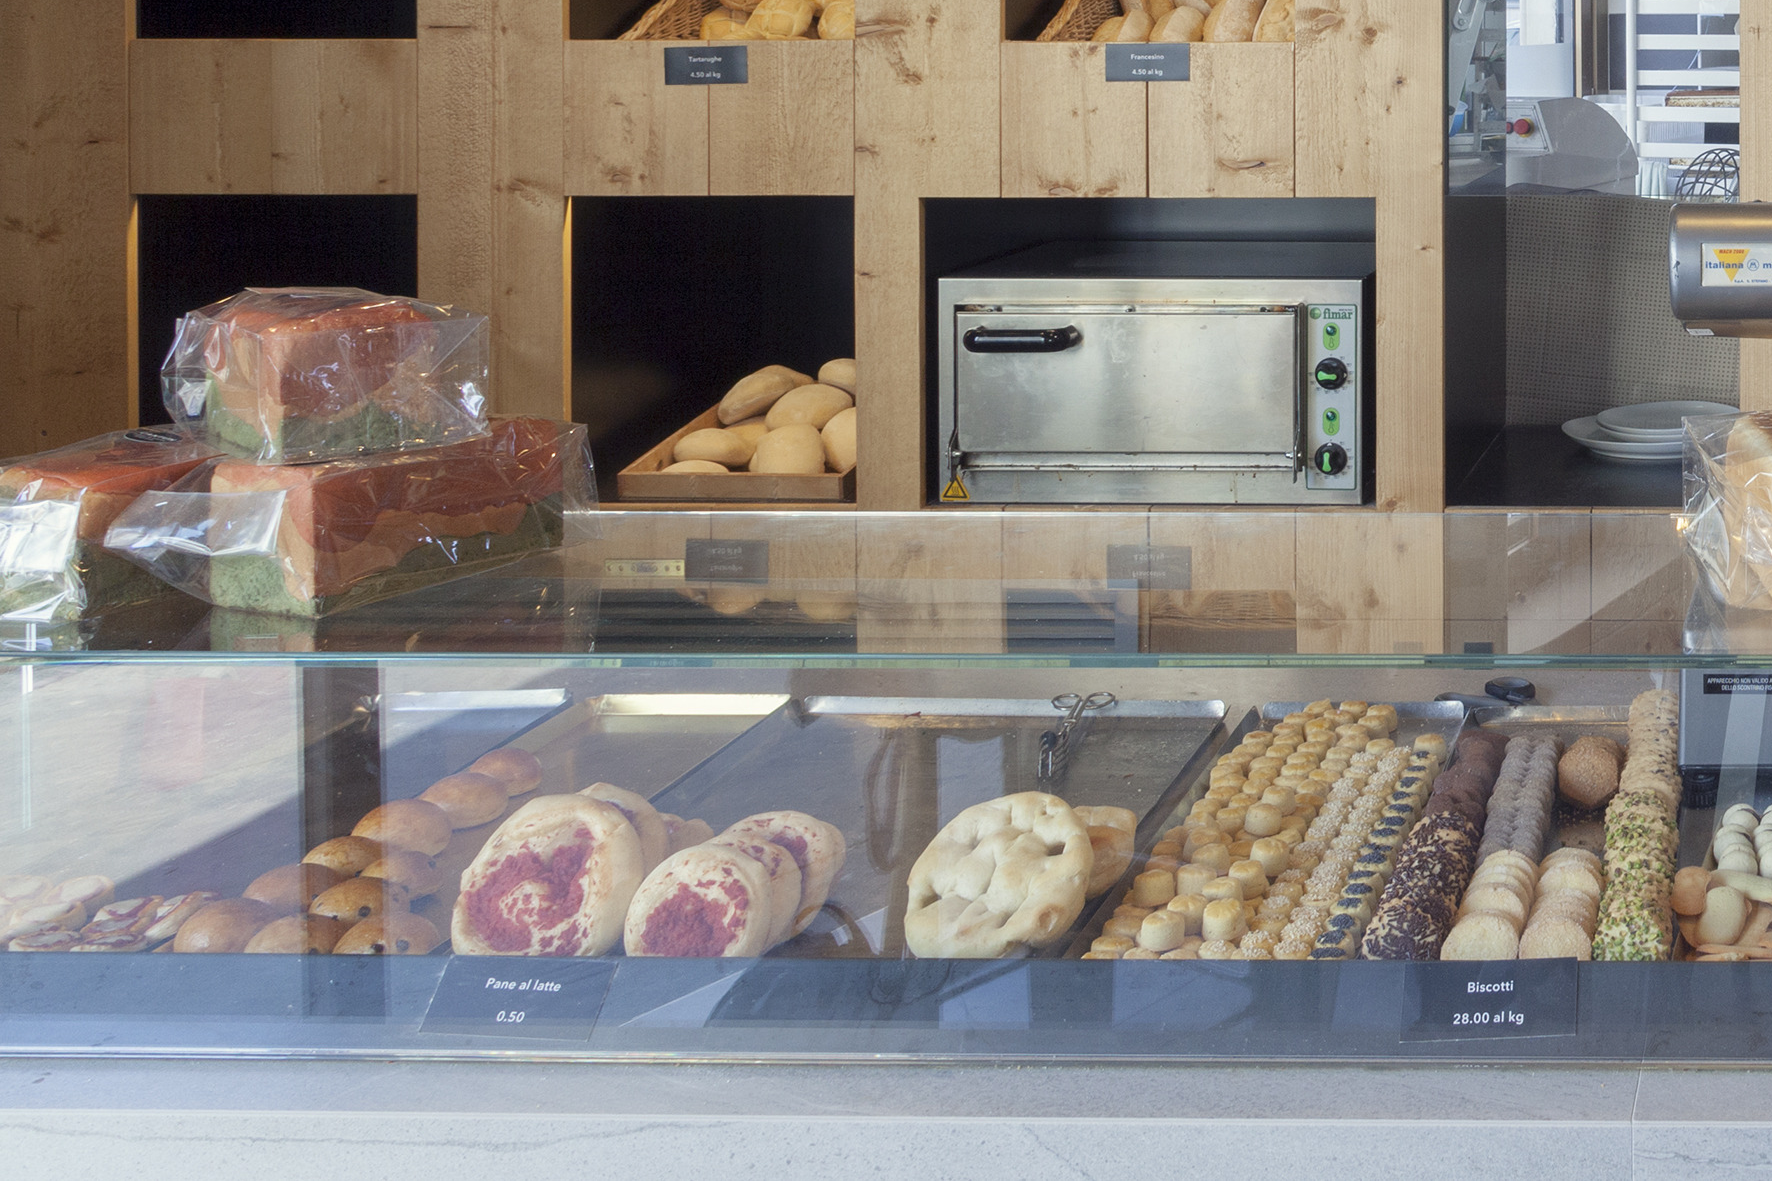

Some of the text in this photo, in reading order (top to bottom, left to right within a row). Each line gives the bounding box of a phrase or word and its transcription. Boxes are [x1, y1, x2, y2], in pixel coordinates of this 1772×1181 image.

[712, 71, 721, 79] kg
[1705, 261, 1744, 269] italiana
[1323, 308, 1353, 319] fimar
[485, 977, 561, 992] Pane al latte
[1467, 980, 1514, 993] Biscotti
[496, 1010, 525, 1023] 0.50
[1452, 1010, 1525, 1025] 28.00 al kg
